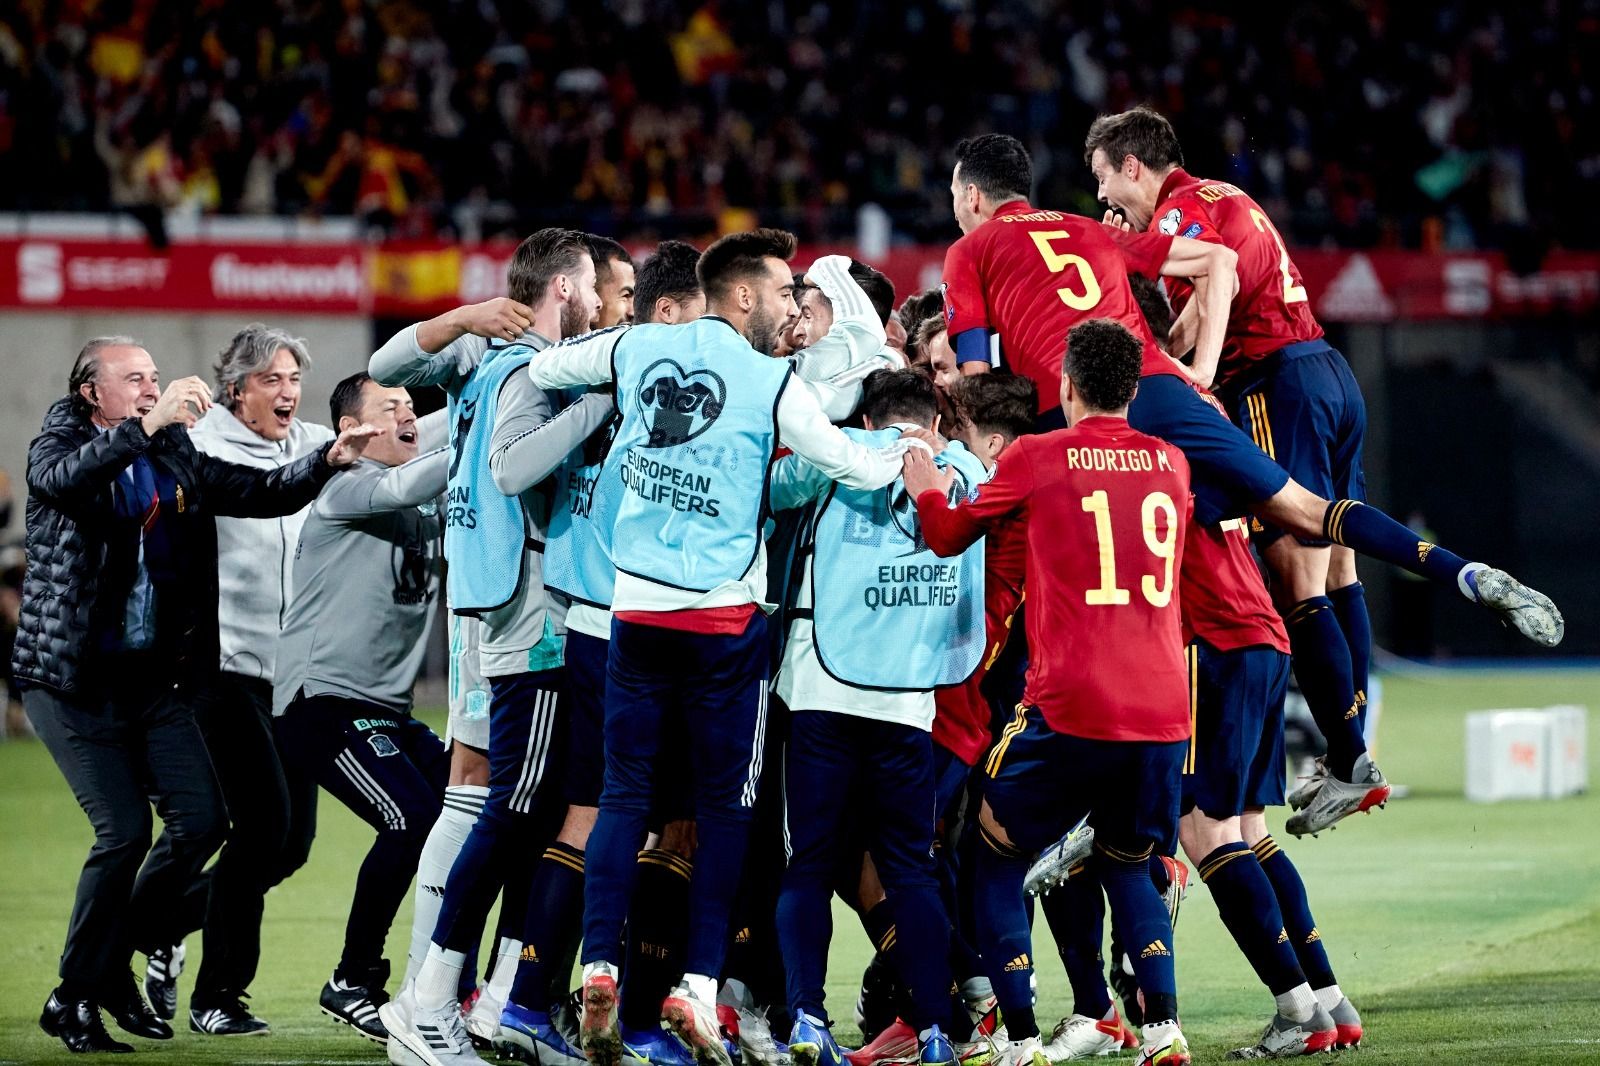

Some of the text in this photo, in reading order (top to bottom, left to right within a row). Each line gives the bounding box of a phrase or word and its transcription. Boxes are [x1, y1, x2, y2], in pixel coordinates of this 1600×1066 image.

[1027, 230, 1103, 311] 5
[1249, 208, 1309, 304] 2
[626, 448, 711, 494] EUROPEAN
[1067, 447, 1177, 473] RODRIGO M.
[620, 463, 720, 518] QUALIFIERS
[878, 564, 958, 584] EUROPEA
[1081, 490, 1178, 608] 19
[1141, 949, 1171, 959] adidas
